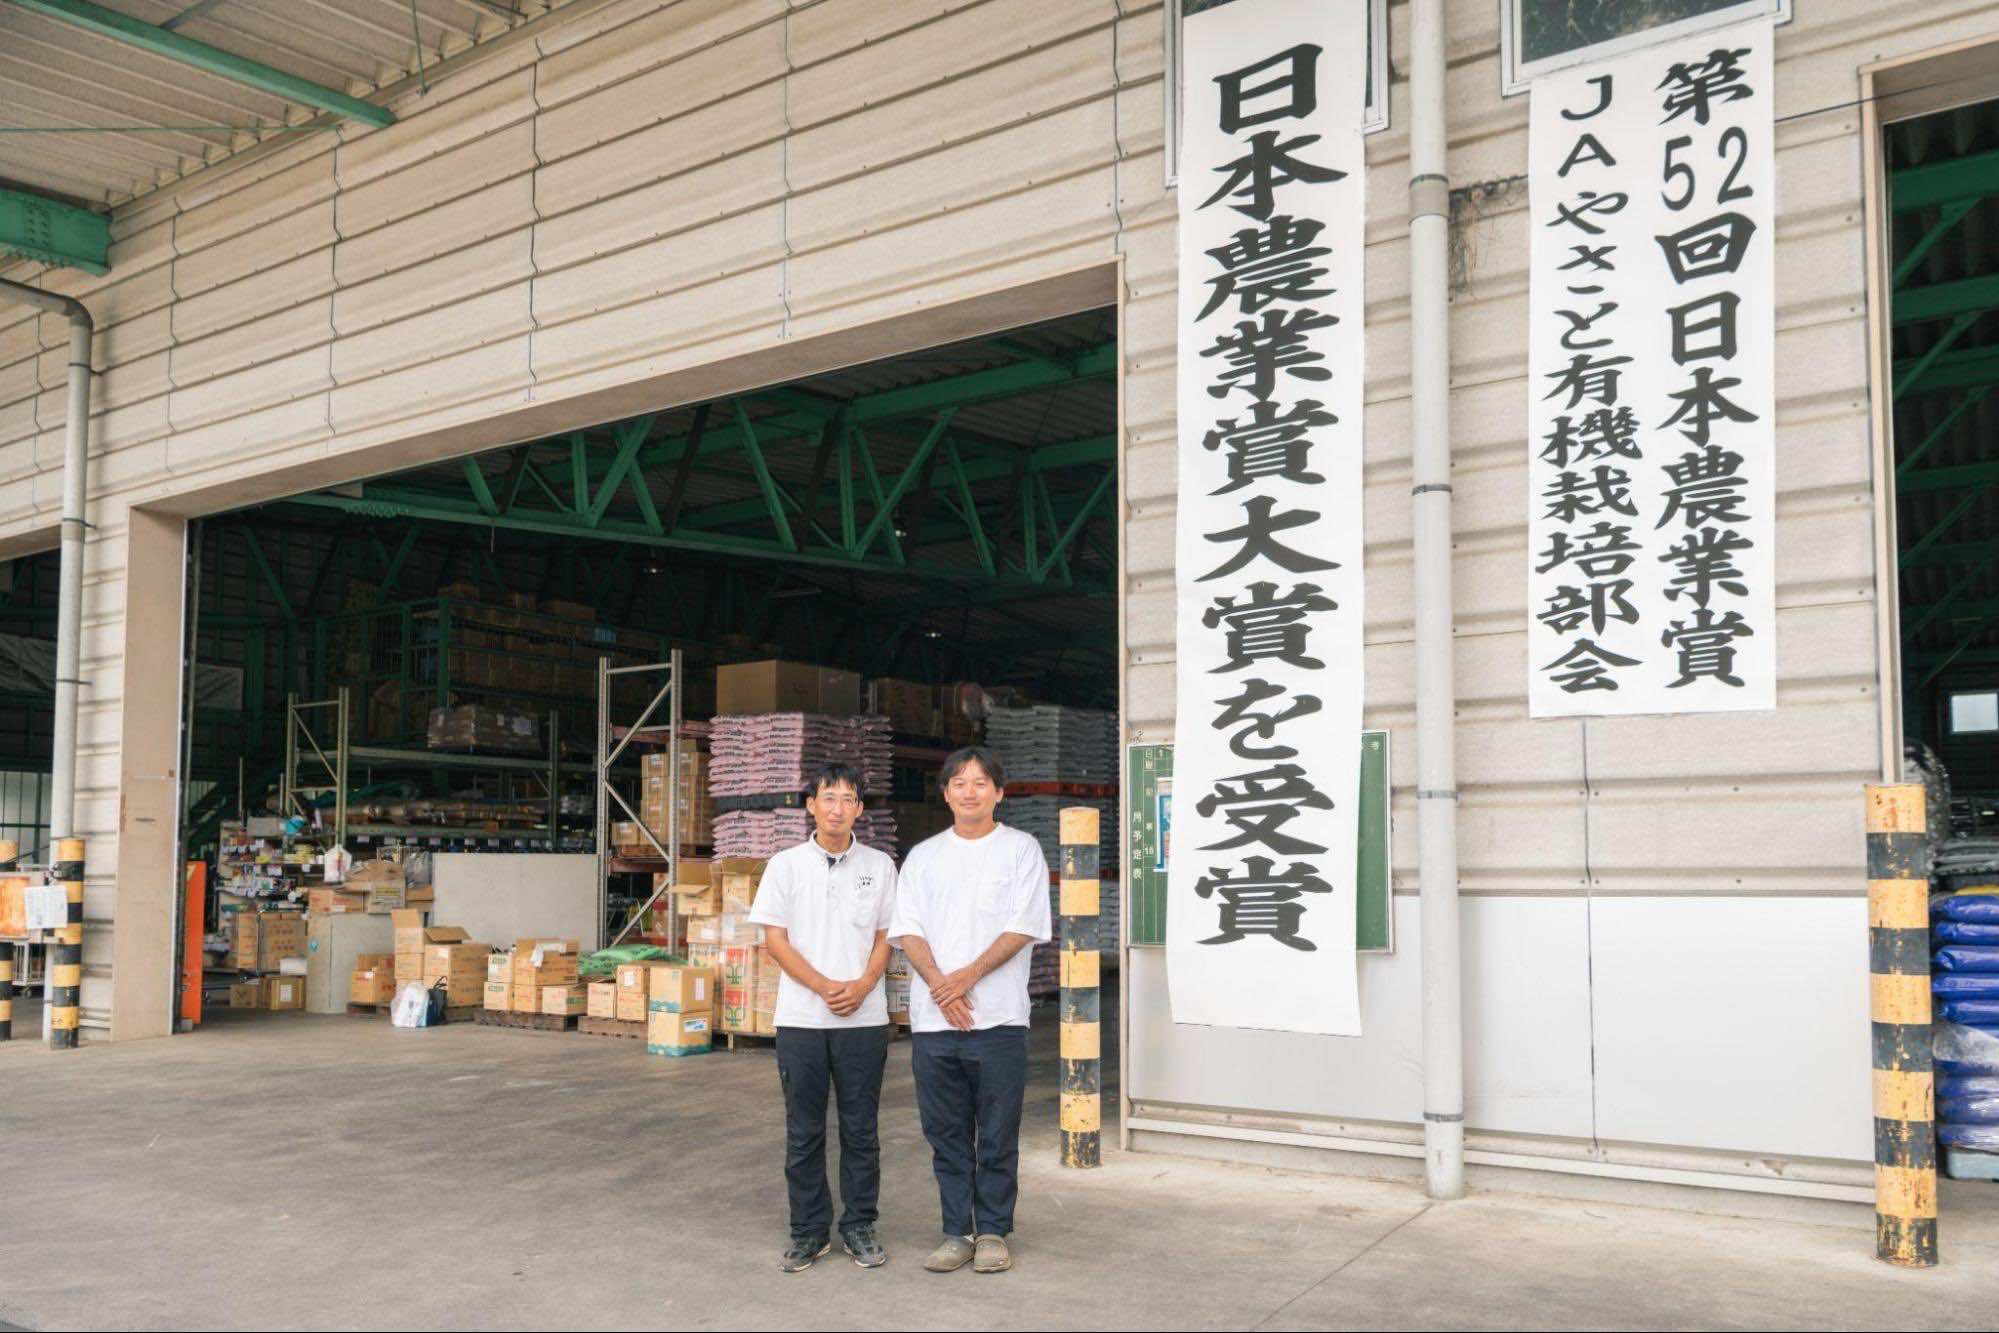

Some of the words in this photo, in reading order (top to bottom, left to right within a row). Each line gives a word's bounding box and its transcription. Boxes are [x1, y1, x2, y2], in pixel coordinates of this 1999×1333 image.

[1193, 42, 1349, 952] 日本農業賞大賞を受賞
[1535, 74, 1643, 694] JAやさと有機栽培部会
[1654, 48, 1759, 689] 第52回日本農業賞
